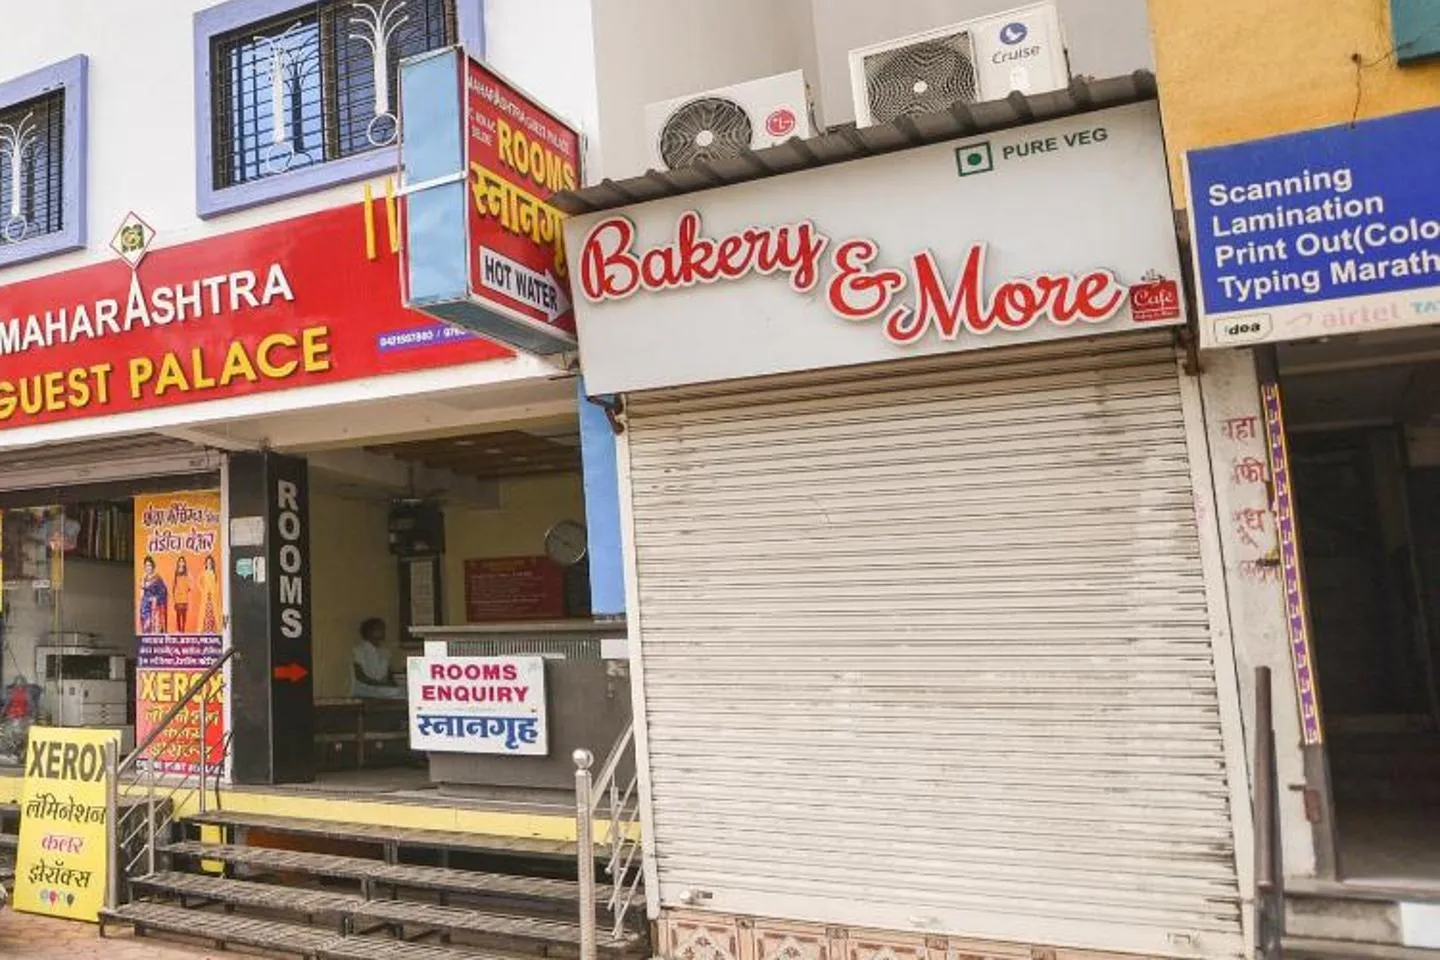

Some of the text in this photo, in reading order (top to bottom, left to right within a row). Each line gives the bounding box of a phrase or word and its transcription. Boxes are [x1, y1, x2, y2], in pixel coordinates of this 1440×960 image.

[992, 46, 1040, 64] Cruise
[497, 119, 576, 192] ROOMS
[1003, 128, 1108, 159] PURE VEG
[1209, 168, 1353, 207] Scanning
[470, 161, 567, 278] स्नानगृ
[1212, 196, 1384, 237] Lamination
[1215, 238, 1288, 269] Print
[485, 255, 558, 311] HOT WATER
[579, 212, 1123, 342] Bakery & More
[1217, 269, 1321, 303] Typing
[1323, 303, 1402, 329] airtel
[129, 326, 330, 399] PALACE
[277, 479, 303, 639] ROOMS
[430, 664, 517, 681] ROOMS
[422, 685, 529, 702] ENQUIRY
[417, 714, 539, 750] स्नानगृह
[41, 833, 84, 854] कलर
